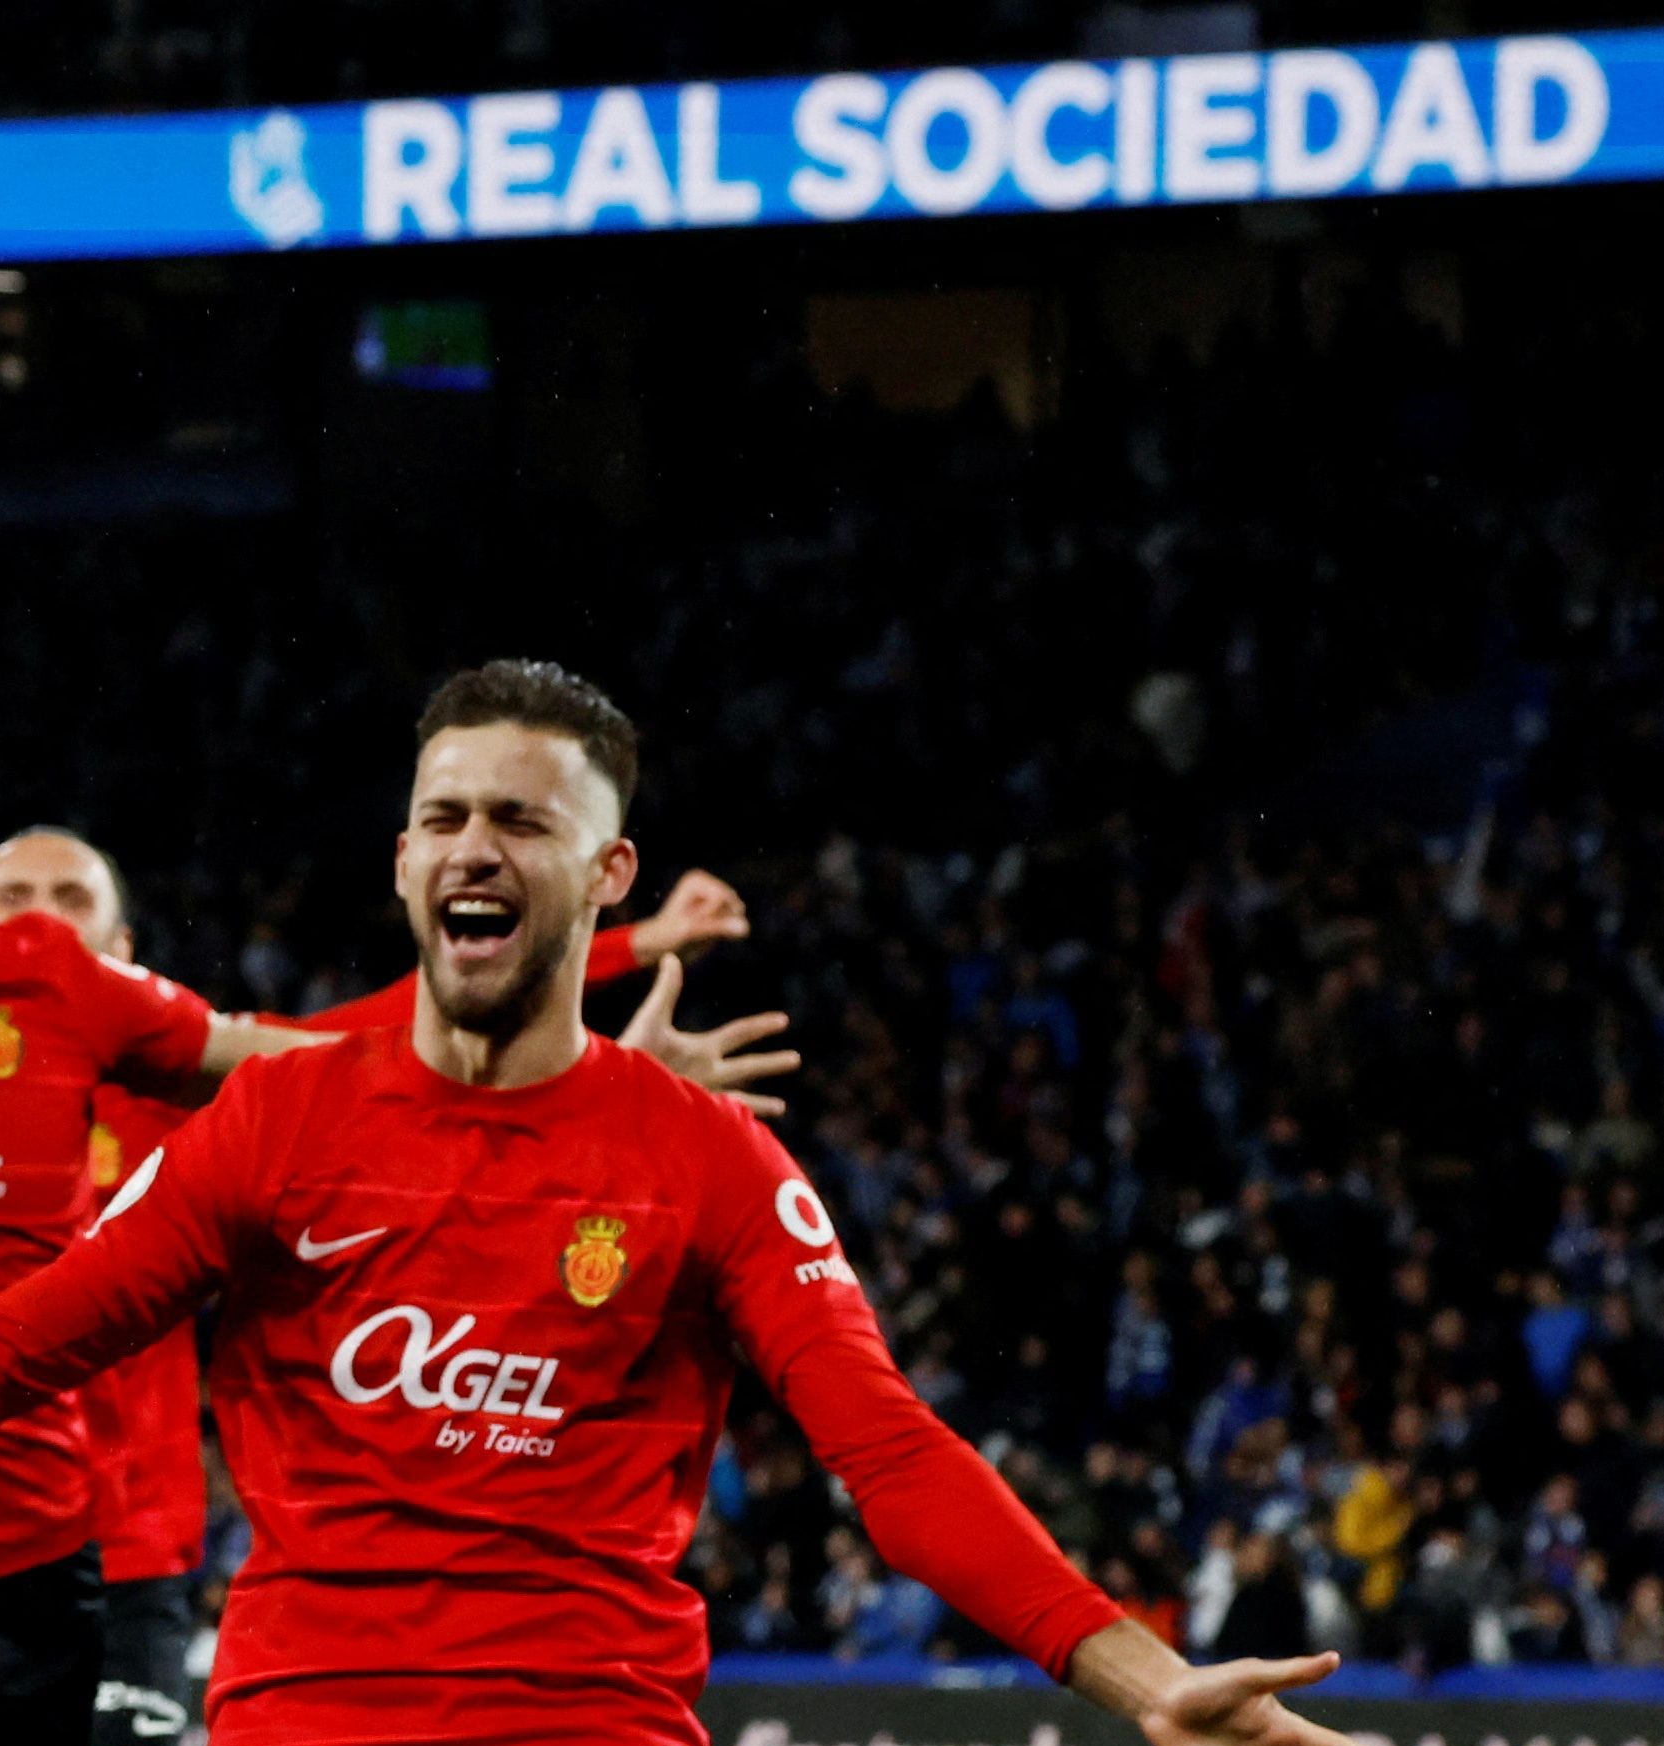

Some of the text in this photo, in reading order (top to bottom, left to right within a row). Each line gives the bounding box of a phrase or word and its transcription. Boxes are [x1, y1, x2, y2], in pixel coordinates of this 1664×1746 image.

[364, 37, 1608, 240] REAL SOCIEDAD
[435, 1420, 556, 1457] by Taica
